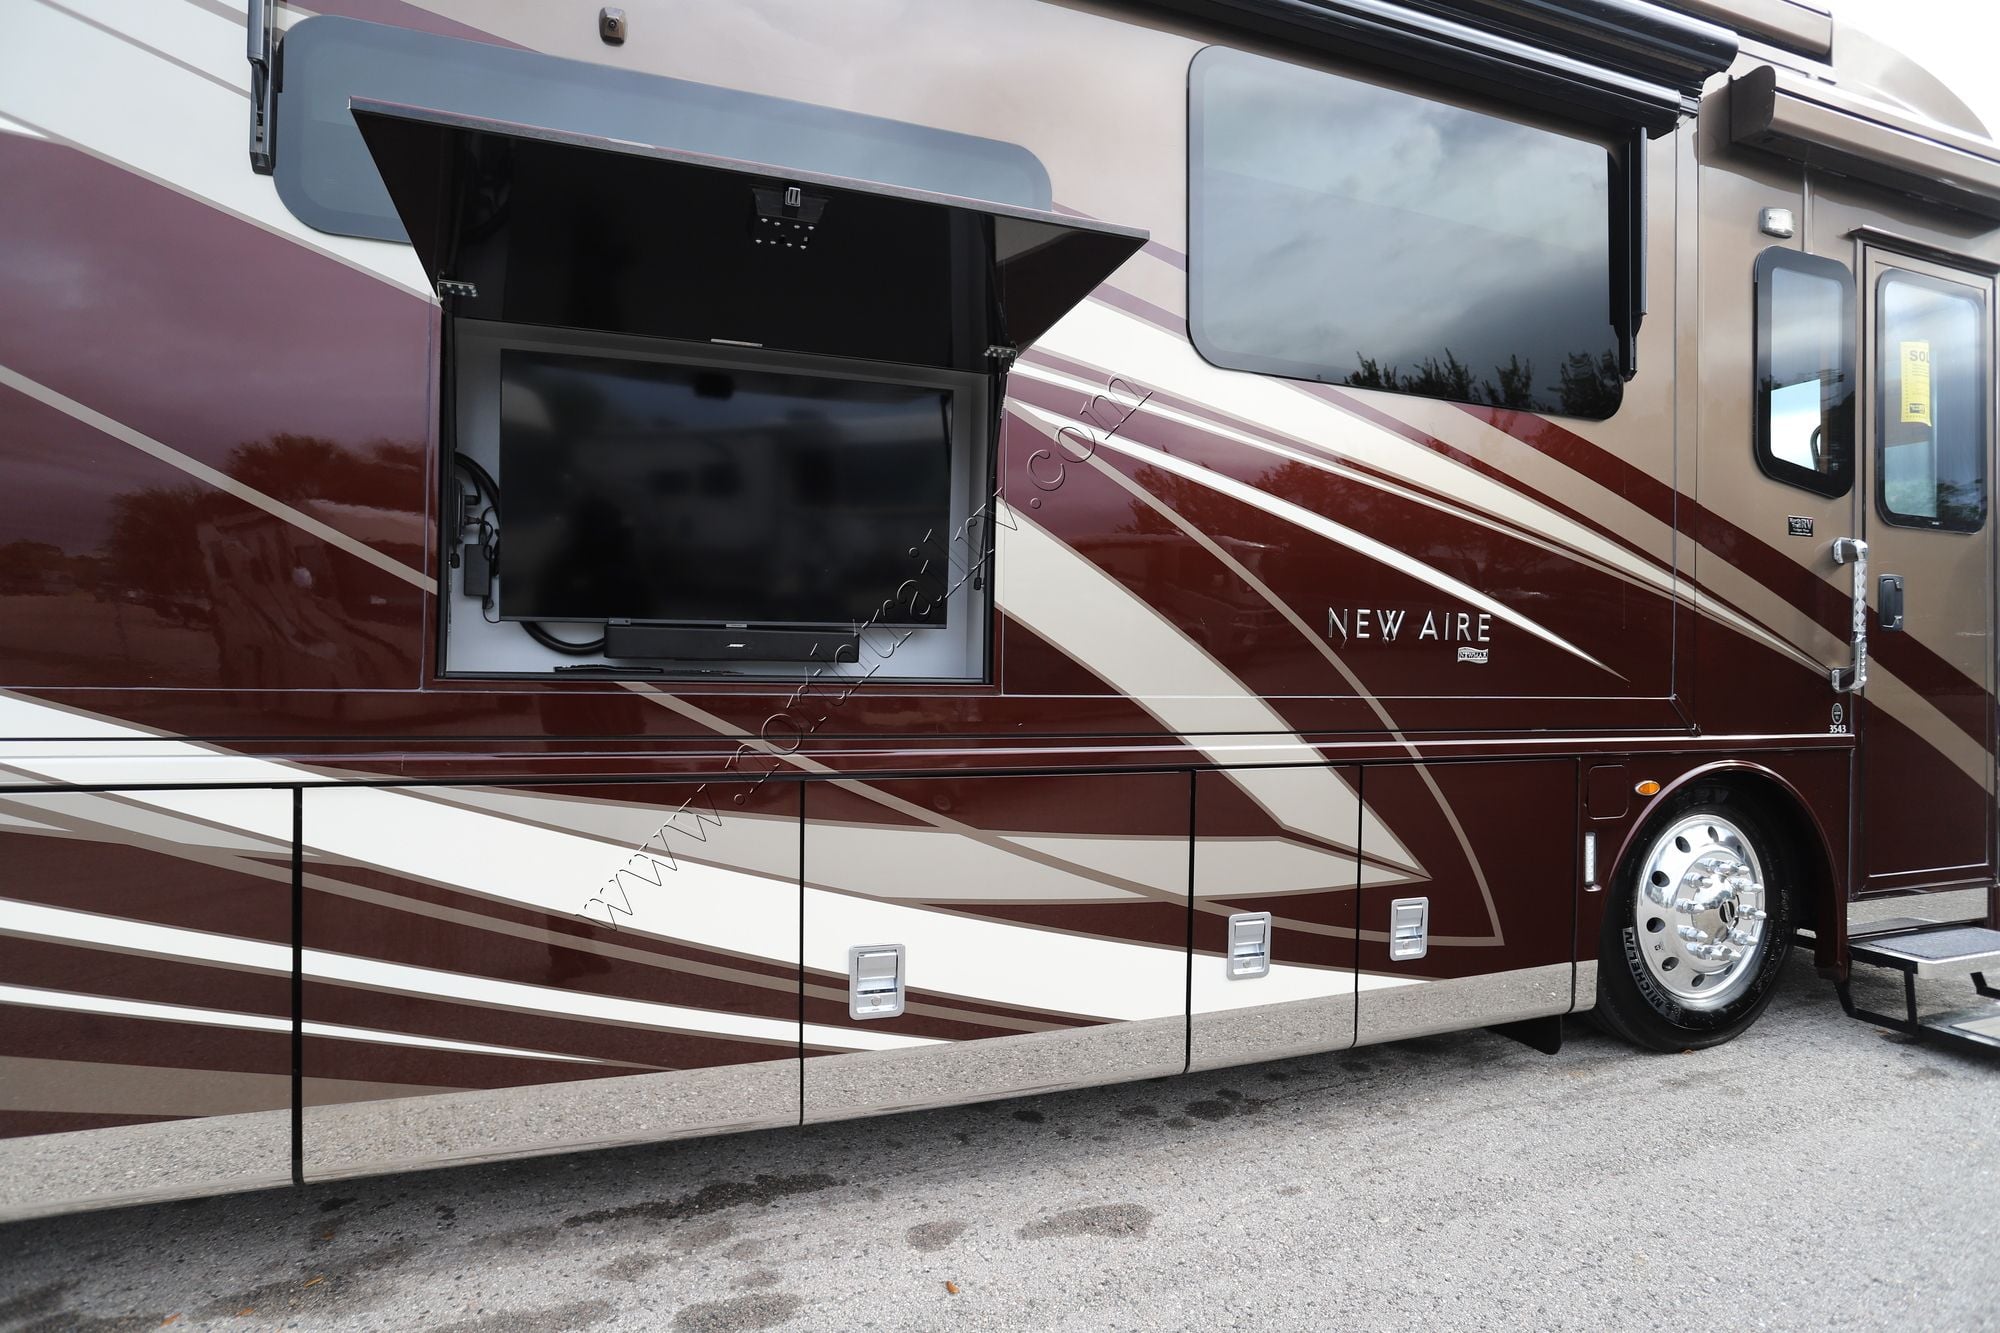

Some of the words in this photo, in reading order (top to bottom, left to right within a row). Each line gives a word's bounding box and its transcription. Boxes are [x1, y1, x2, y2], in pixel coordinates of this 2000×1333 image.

[1328, 606, 1406, 642] NEW
[1418, 610, 1492, 642] AIRE
[1829, 724, 1847, 733] 3543
[1624, 930, 1665, 1008] MICHELIN
